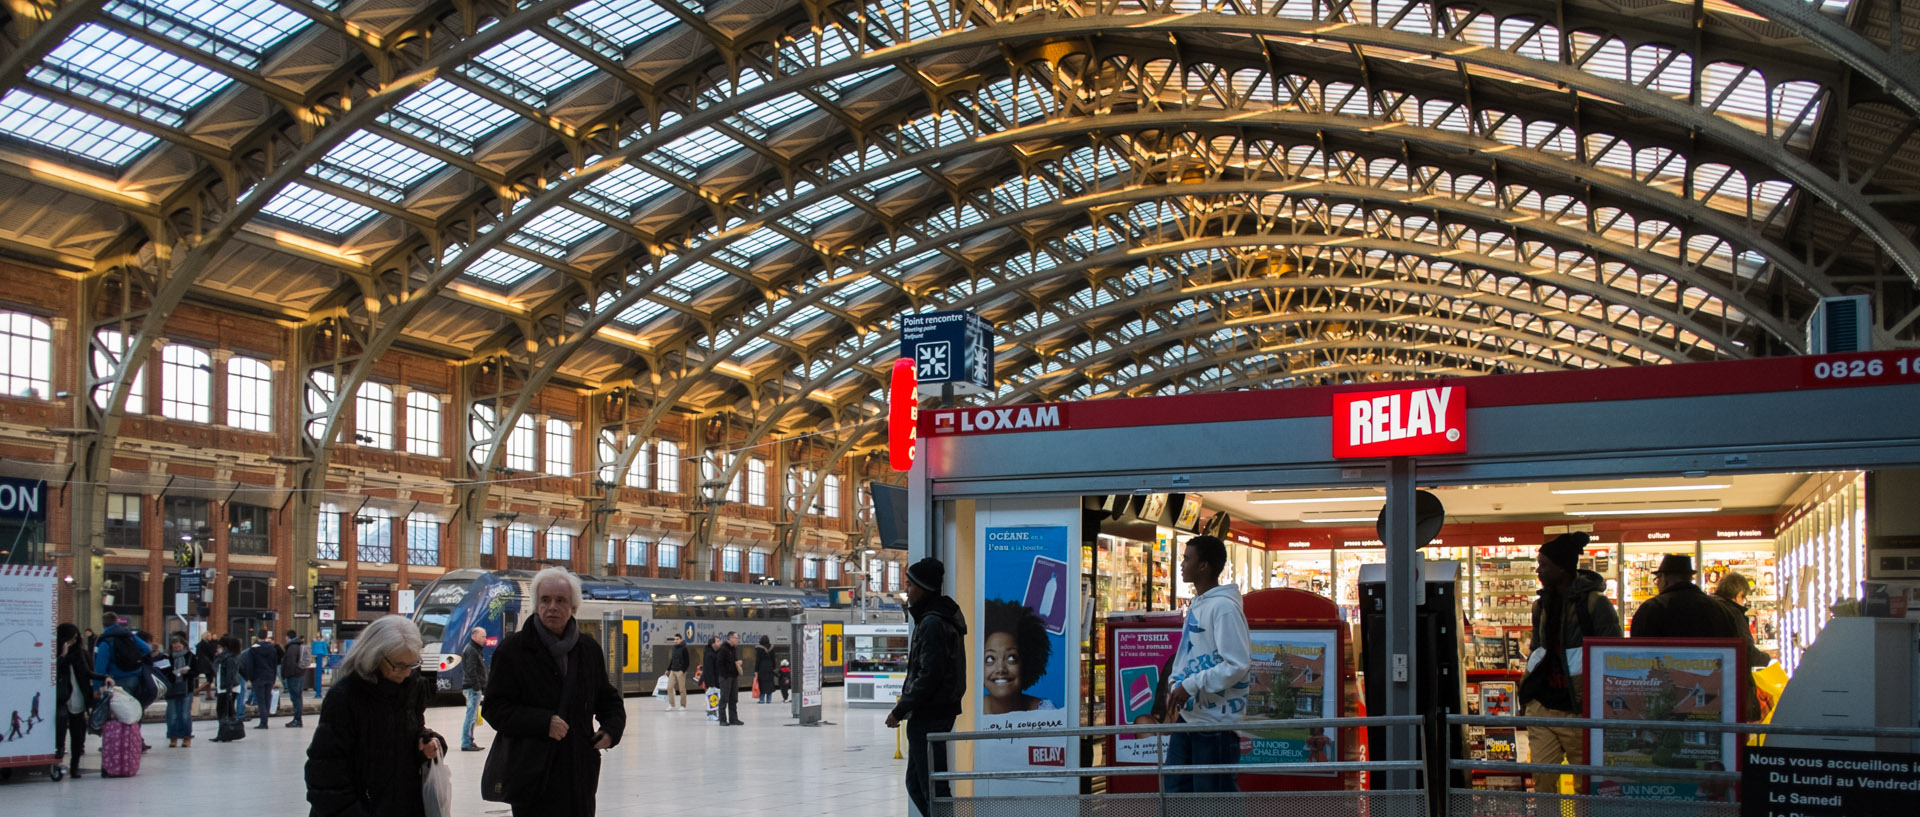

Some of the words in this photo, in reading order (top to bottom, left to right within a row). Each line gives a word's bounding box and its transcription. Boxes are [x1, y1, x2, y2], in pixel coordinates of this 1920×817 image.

[904, 317, 923, 326] Point
[925, 314, 963, 324] rencontre
[1814, 359, 1884, 379] 0826
[908, 366, 918, 460] TABAC
[961, 406, 1060, 432] LOXAM
[1350, 386, 1452, 446] RELAY
[989, 531, 1029, 540] OCÉANE
[1606, 655, 1653, 669] Maison
[1664, 655, 1719, 670] Travaux
[1605, 677, 1662, 686] S'agrandir
[1018, 720, 1062, 730] soupçonne
[1267, 741, 1289, 749] NORD
[1490, 744, 1510, 752] 2014
[1032, 747, 1061, 762] RELAY
[1253, 749, 1303, 757] CHALEUREUX
[1750, 754, 1785, 765] Nous
[1789, 758, 1823, 768] vous
[1827, 760, 1908, 772] accueillons
[1769, 772, 1789, 783] Du
[1792, 773, 1832, 786] Lundi
[1836, 778, 1854, 787] au
[1858, 777, 1920, 791] Vendredi
[1622, 785, 1639, 794] UN
[1641, 785, 1675, 794] NORD
[1769, 792, 1786, 803] Le
[1790, 793, 1842, 807] Samedi
